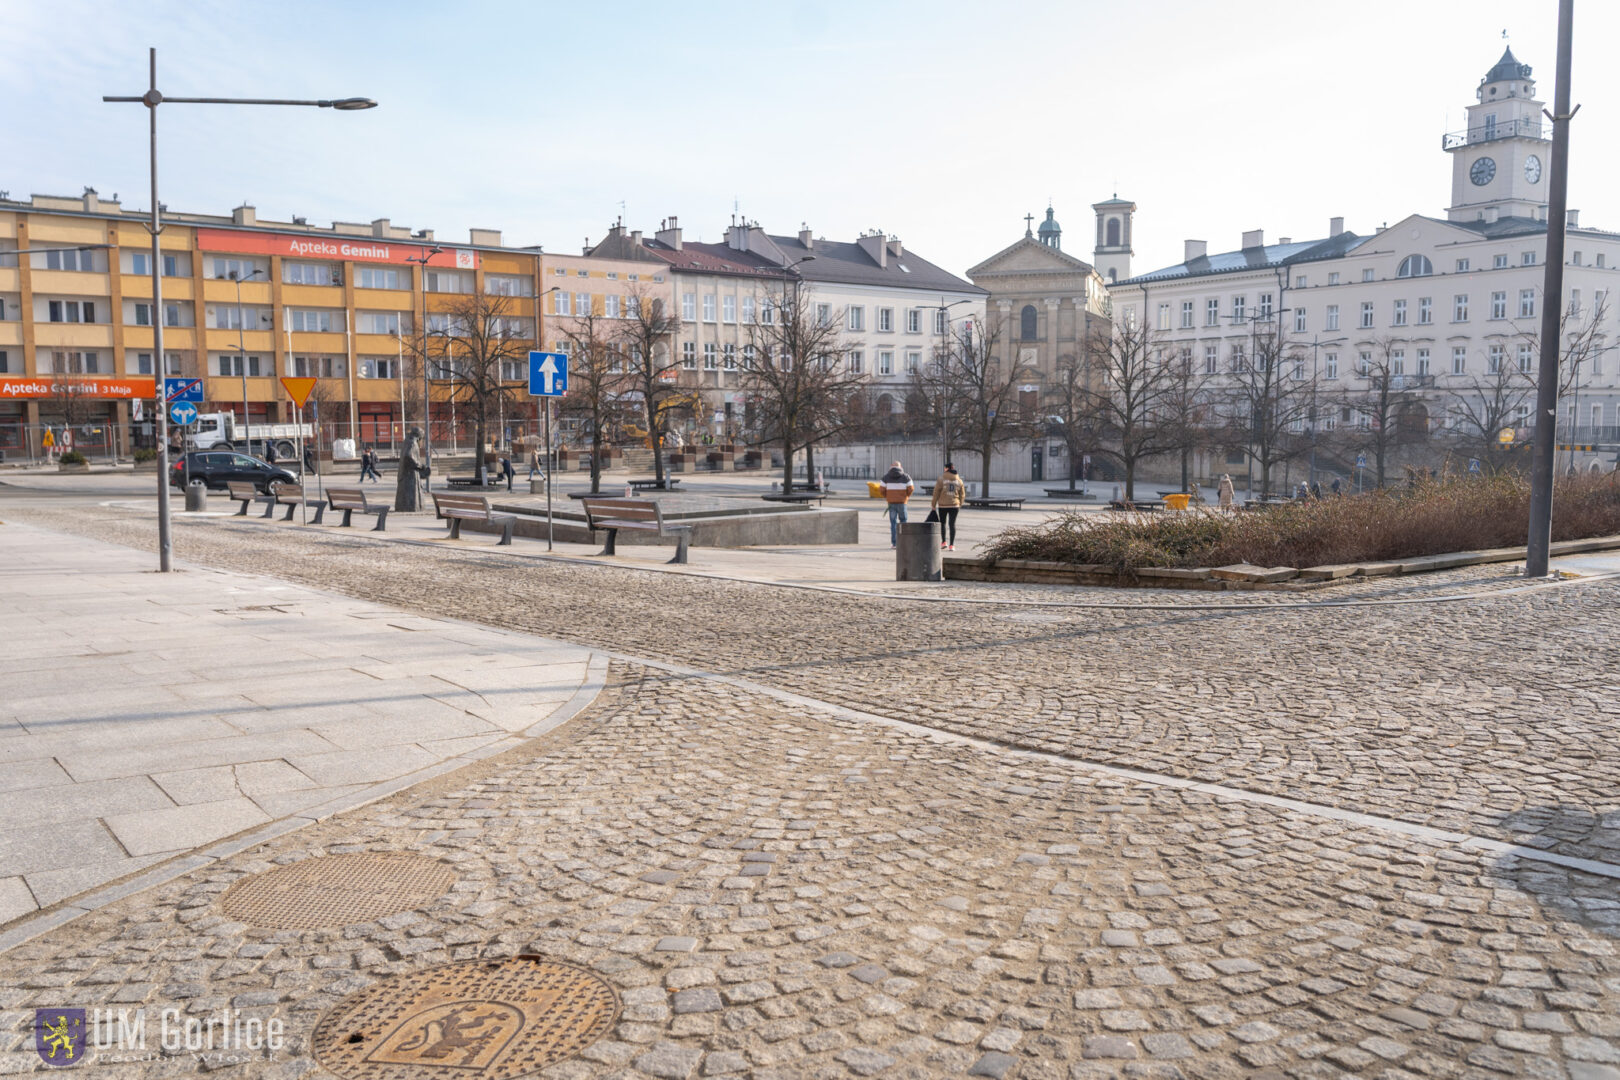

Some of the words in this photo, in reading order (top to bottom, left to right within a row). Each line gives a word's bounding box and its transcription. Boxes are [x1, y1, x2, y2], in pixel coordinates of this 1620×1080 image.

[290, 240, 337, 255] Apteka
[341, 244, 389, 258] Gemini
[3, 382, 47, 395] Apteka
[110, 386, 131, 395] Maja
